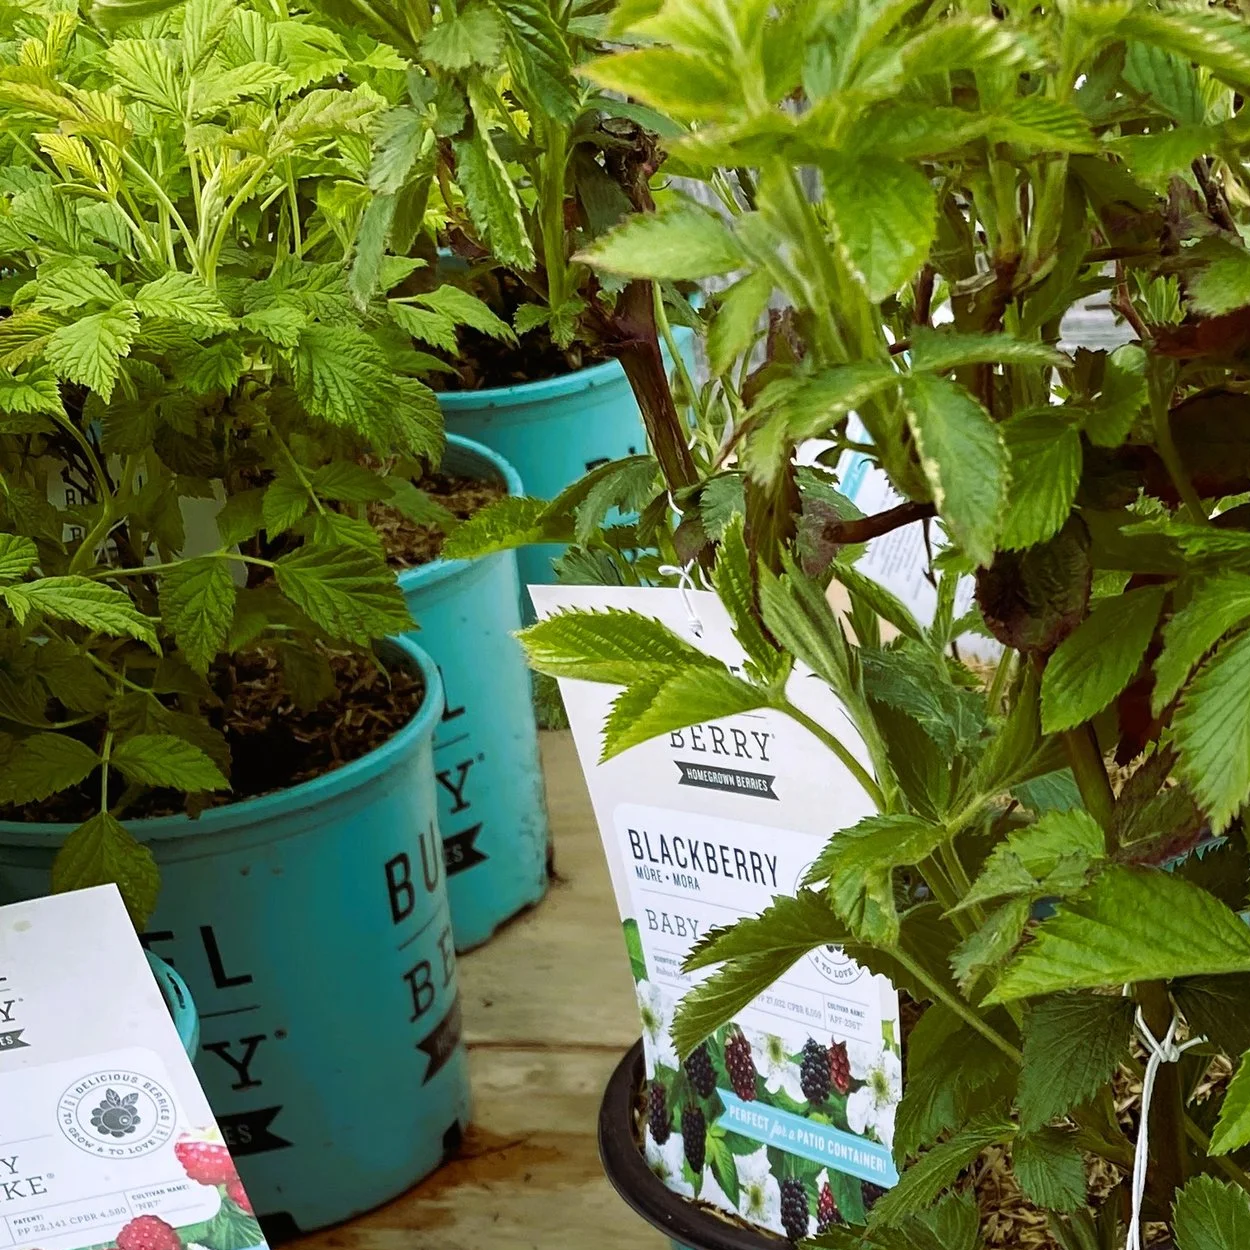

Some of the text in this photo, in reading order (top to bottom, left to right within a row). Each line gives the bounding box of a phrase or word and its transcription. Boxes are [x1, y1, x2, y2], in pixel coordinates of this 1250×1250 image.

[670, 724, 771, 762] BERRY
[686, 767, 768, 792] HOMEGROWN BERRIES
[627, 828, 778, 888] BLACKBERRY
[672, 872, 700, 891] MORA
[645, 908, 699, 940] BABY
[75, 1074, 170, 1121] DELICIOUS BERRIES
[128, 1139, 156, 1154] LOVE
[729, 1104, 887, 1174] PERFECT for a PATIO CONTAINER!
